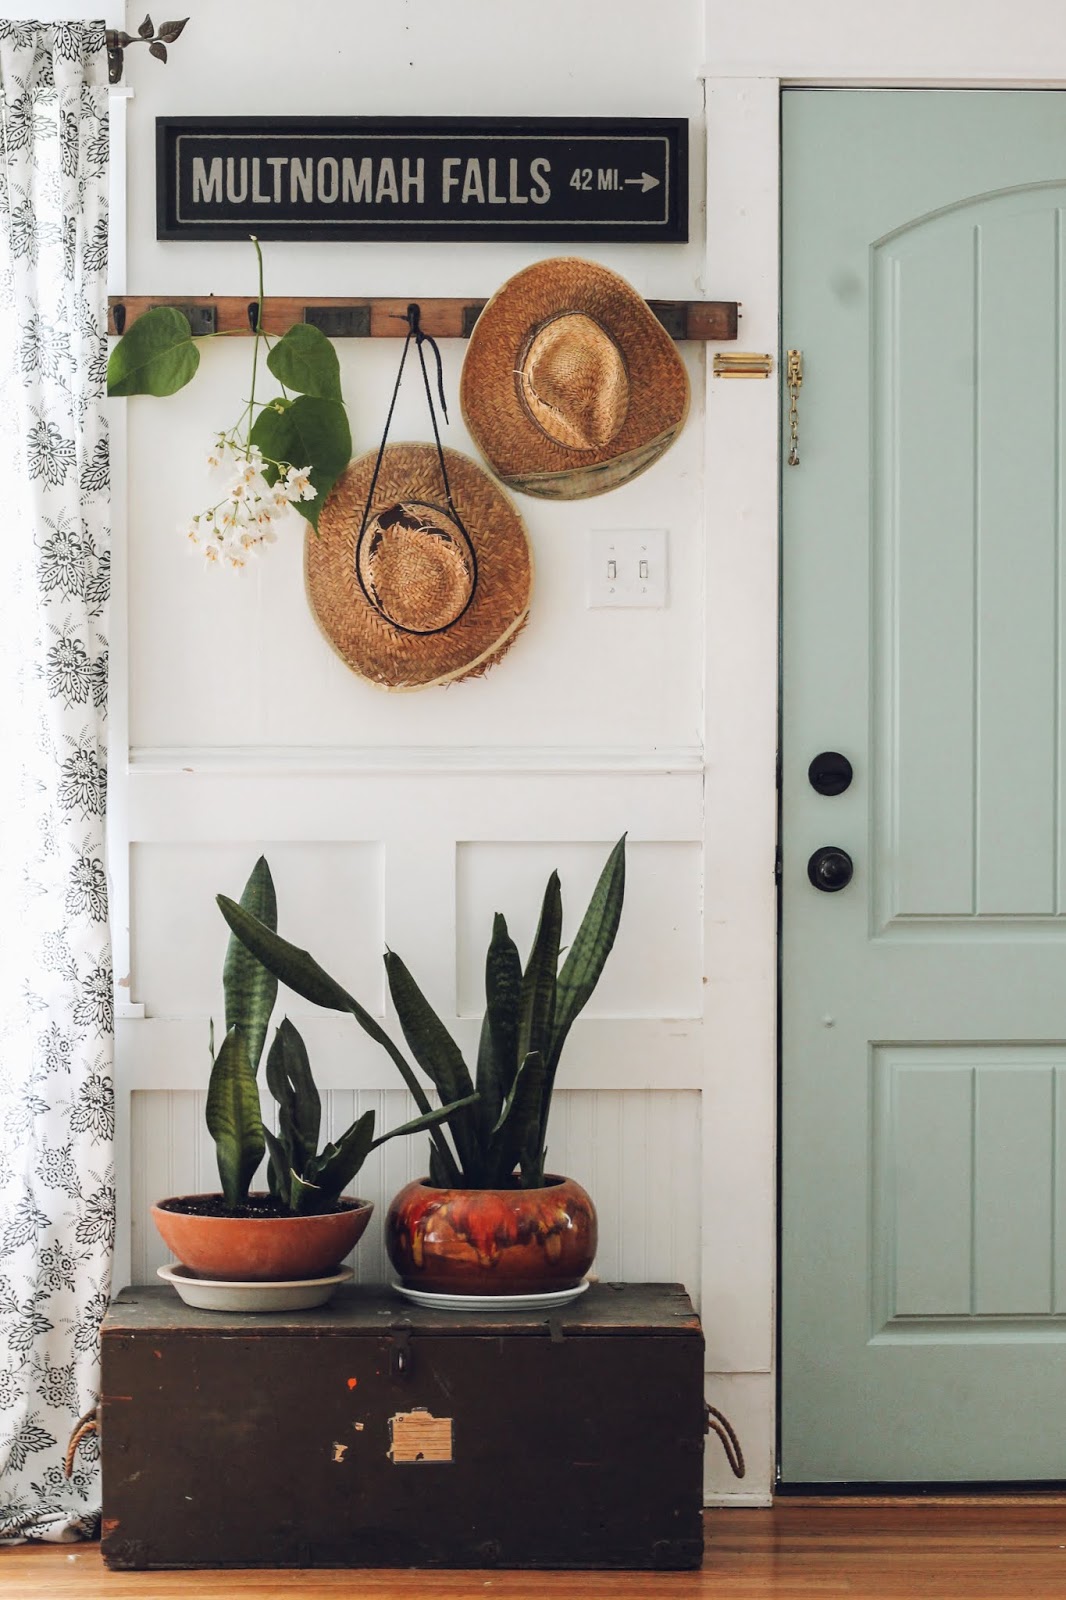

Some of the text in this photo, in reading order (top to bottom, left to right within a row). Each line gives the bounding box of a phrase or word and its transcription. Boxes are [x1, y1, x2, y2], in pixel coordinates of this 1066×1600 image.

[192, 157, 623, 205] MULTNOMAH FALLS 42 MI.
